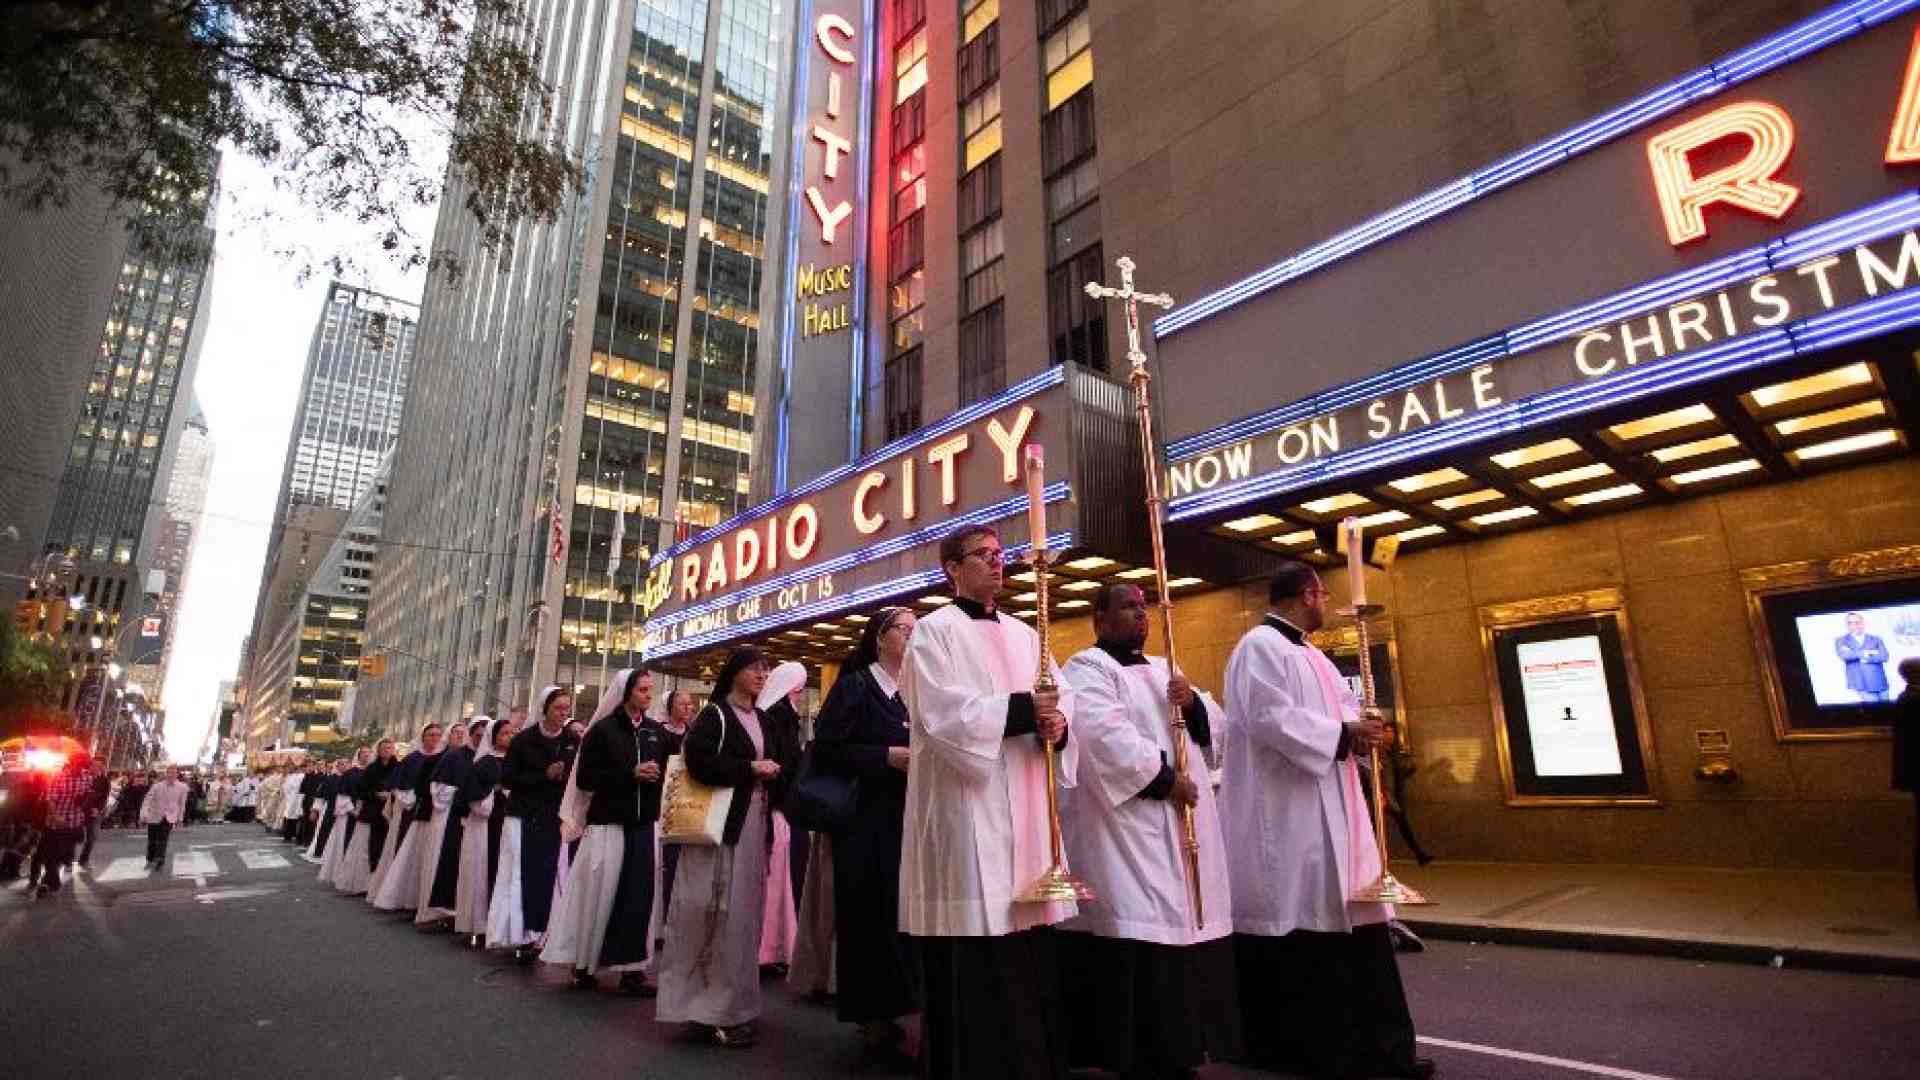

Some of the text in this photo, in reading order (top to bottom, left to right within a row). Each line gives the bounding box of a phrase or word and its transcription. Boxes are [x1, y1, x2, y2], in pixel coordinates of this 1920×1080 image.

[806, 13, 856, 245] CITY
[1574, 230, 1920, 377] CHRISTM
[682, 405, 1036, 600] RADIO CITY
[1169, 363, 1502, 497] NOW ON SALE
[778, 582, 808, 609] OCT
[818, 575, 834, 598] 15
